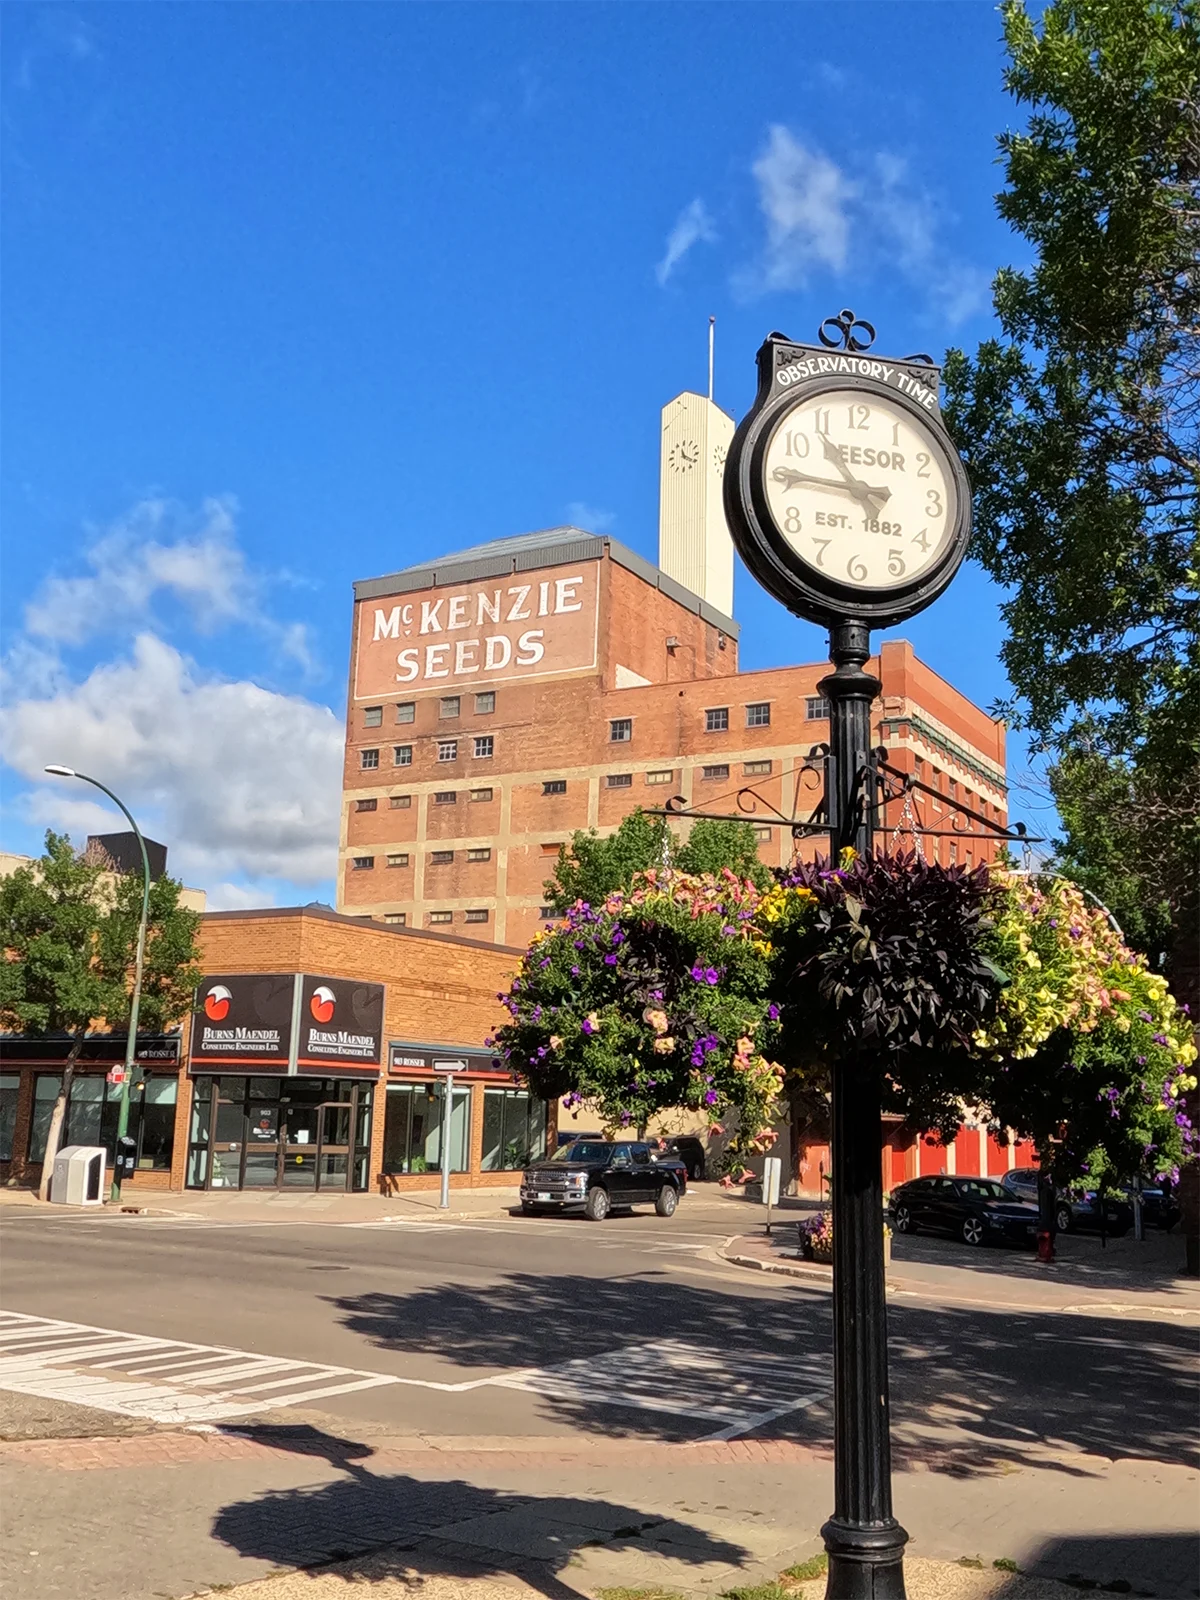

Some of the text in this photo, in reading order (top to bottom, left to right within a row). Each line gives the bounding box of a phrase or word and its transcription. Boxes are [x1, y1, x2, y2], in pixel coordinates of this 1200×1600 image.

[776, 357, 938, 409] OBSERVATORY TIME
[814, 407, 831, 435] 11
[847, 404, 871, 431] 12
[785, 430, 810, 458] 10
[892, 422, 900, 447] 1
[836, 444, 906, 472] EESOR
[915, 452, 931, 479] 2
[925, 489, 943, 518] 3
[784, 506, 802, 533] 8
[815, 511, 903, 537] EST. 1882
[811, 537, 832, 566] 7
[911, 528, 932, 553] 4
[846, 554, 868, 581] 6
[887, 548, 906, 577] 5
[395, 629, 545, 682] SEEDS
[403, 1058, 425, 1067] ROSSER
